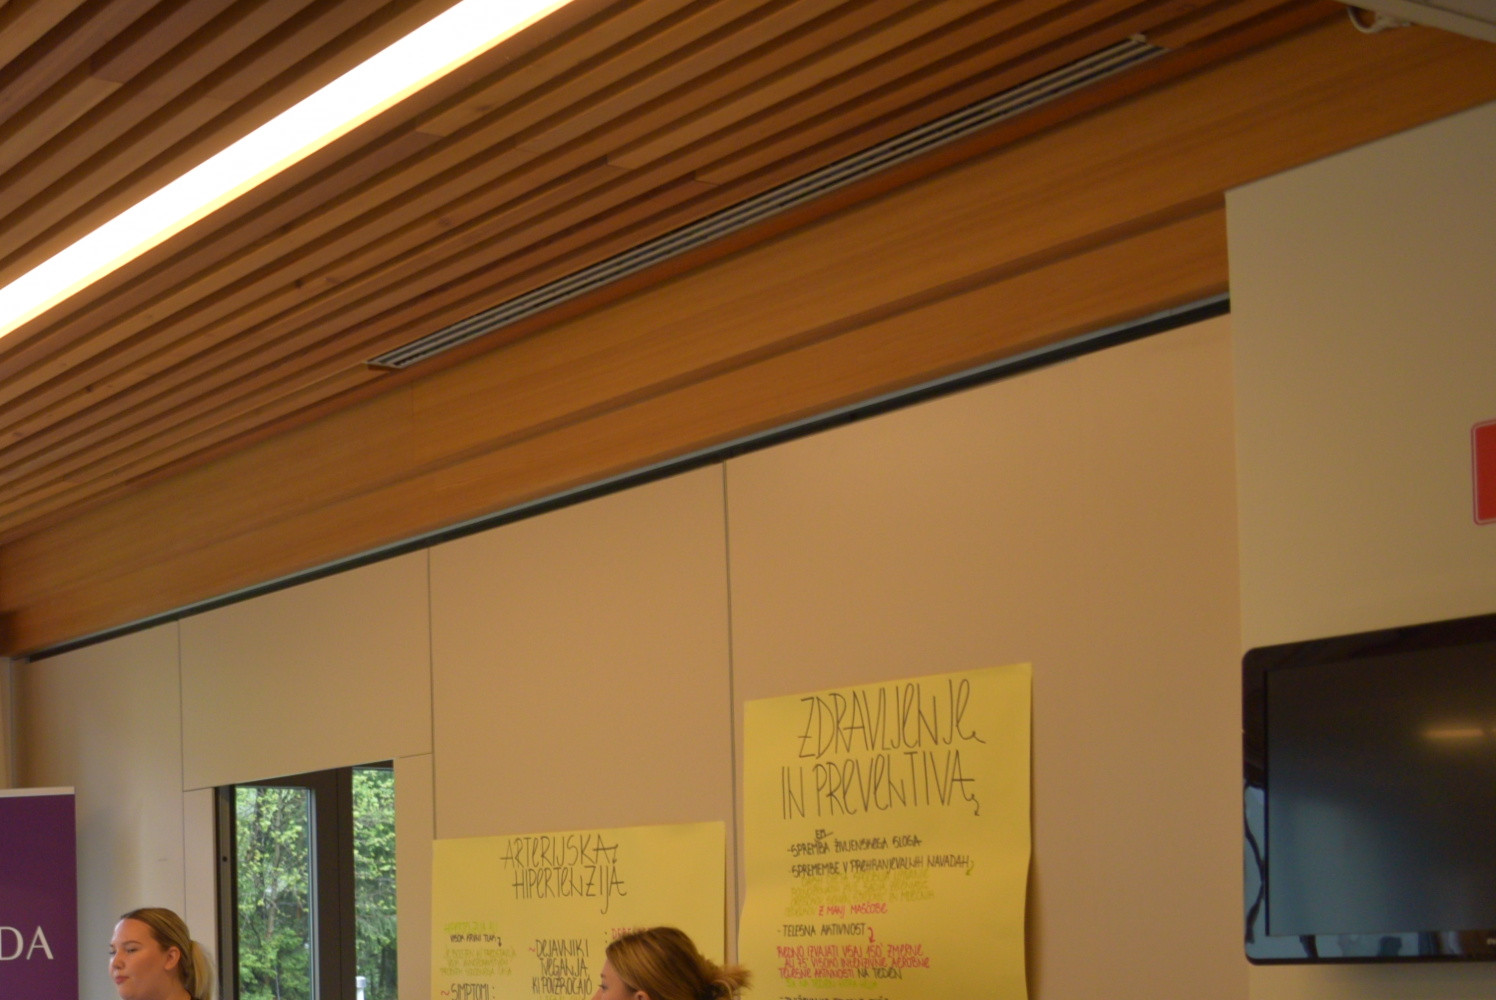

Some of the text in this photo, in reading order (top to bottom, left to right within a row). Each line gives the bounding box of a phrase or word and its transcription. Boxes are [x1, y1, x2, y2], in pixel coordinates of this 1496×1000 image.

[781, 749, 978, 820] IN PREVENTIVA
[512, 865, 627, 915] HIPERTENZIJA
